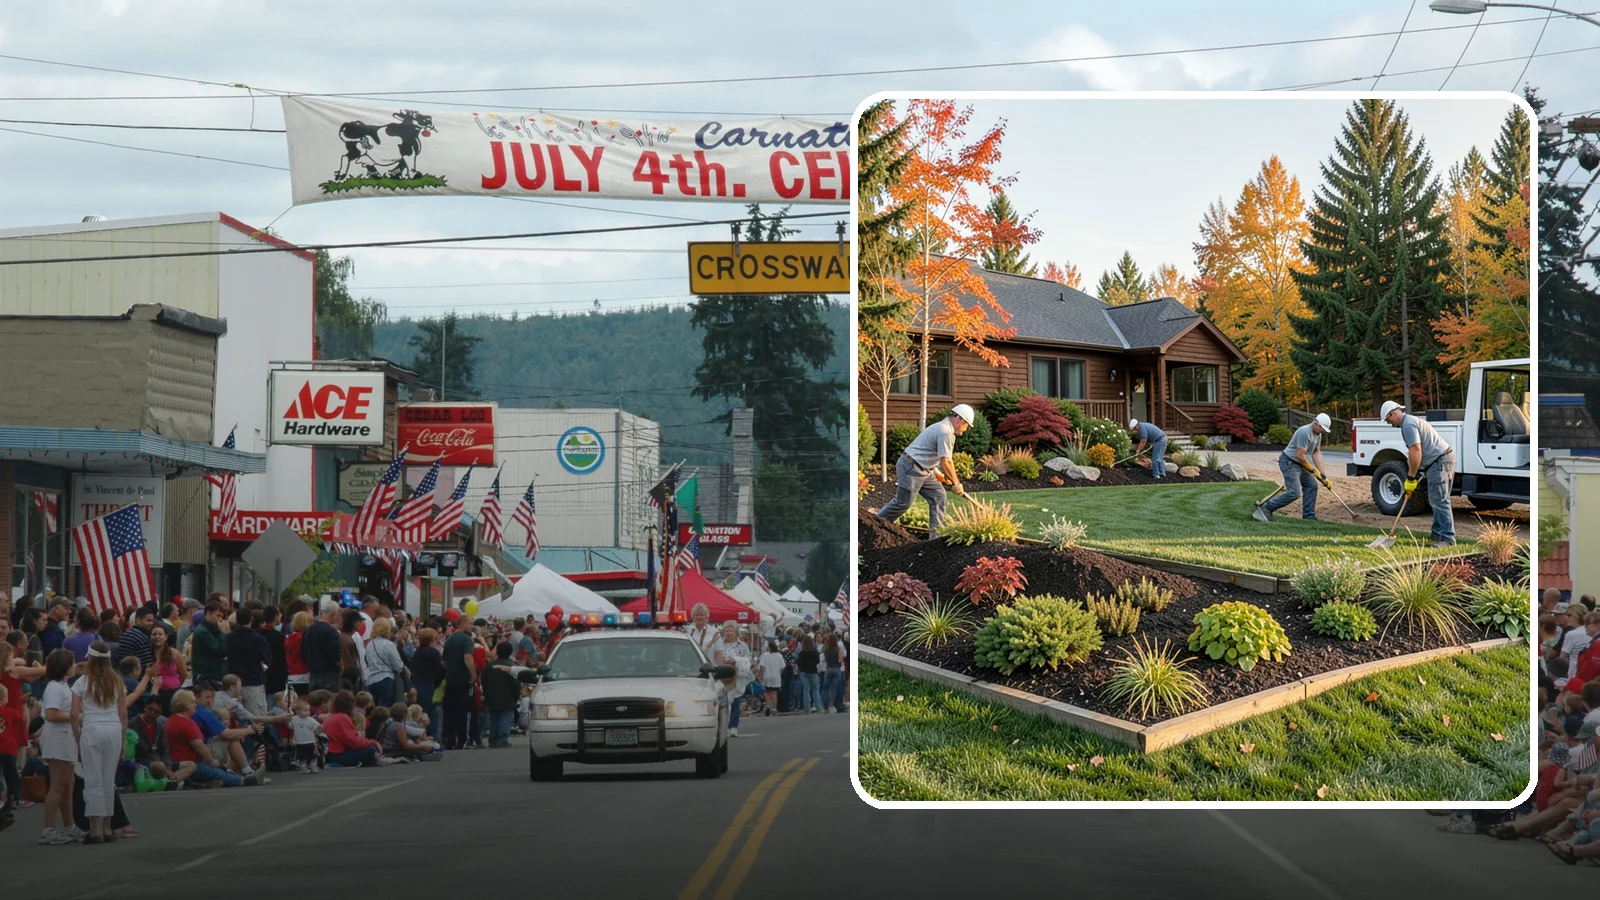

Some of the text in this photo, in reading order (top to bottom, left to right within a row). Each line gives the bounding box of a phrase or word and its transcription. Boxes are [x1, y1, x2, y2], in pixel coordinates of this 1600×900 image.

[481, 141, 605, 192] JULY
[632, 150, 746, 197] 4th.
[697, 253, 850, 279] CROSSWA
[283, 380, 373, 420] ACE
[405, 409, 452, 422] CEDAR
[284, 421, 370, 436] Hardware
[416, 428, 477, 447] Coca-Cola
[95, 484, 124, 495] Vincent
[126, 486, 136, 495] de
[137, 486, 155, 495] Paul
[688, 526, 741, 535] CRNATION
[699, 535, 730, 543] GLASS
